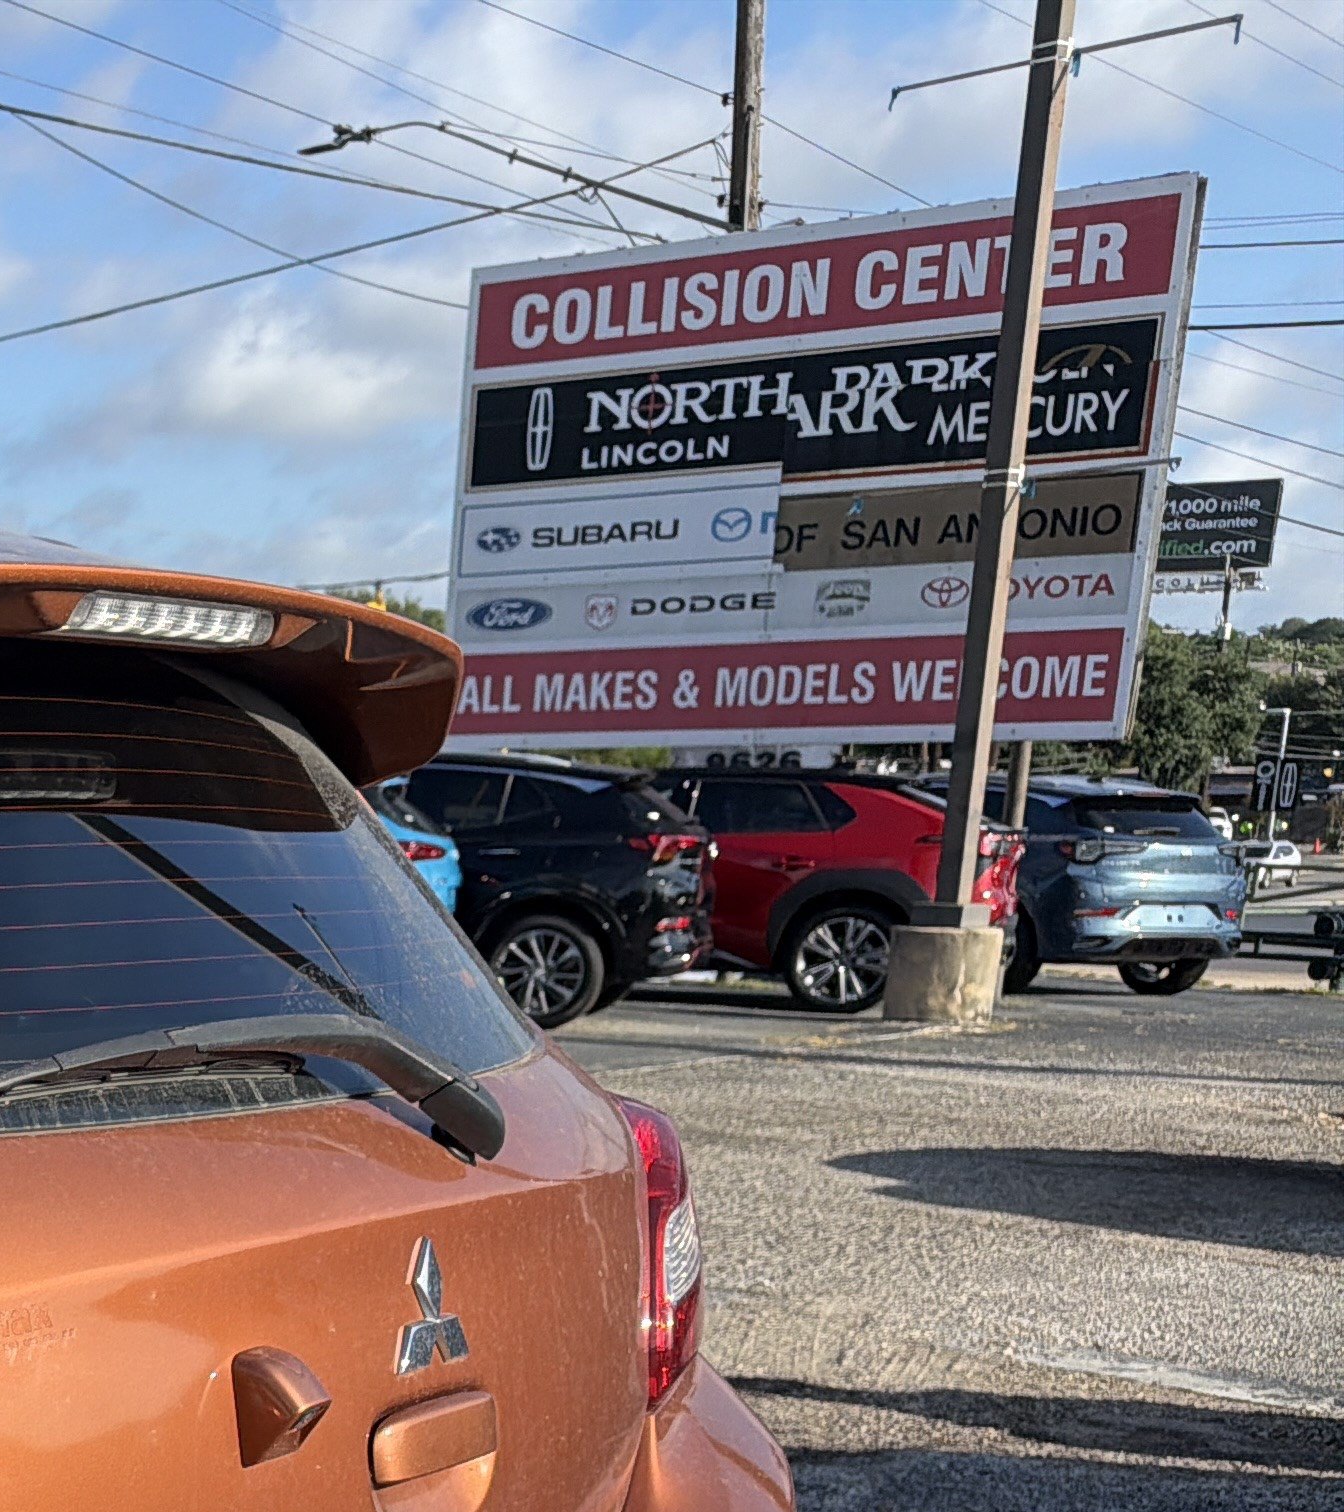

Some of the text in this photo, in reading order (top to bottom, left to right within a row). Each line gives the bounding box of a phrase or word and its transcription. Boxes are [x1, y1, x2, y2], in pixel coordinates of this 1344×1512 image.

[511, 257, 831, 350] COLLISION
[583, 371, 793, 433] NORTH
[581, 388, 1130, 470] LINCOLN MECURY
[531, 518, 680, 548] SUBARU
[774, 522, 819, 555] OF
[840, 516, 920, 551] SAN
[937, 503, 1123, 545] ANONIO
[1184, 516, 1258, 531] Guarantee
[630, 591, 776, 617] DODGE
[1006, 573, 1116, 601] OYOTA
[456, 653, 1110, 715] ALL MAKES & MODELS WECOME
